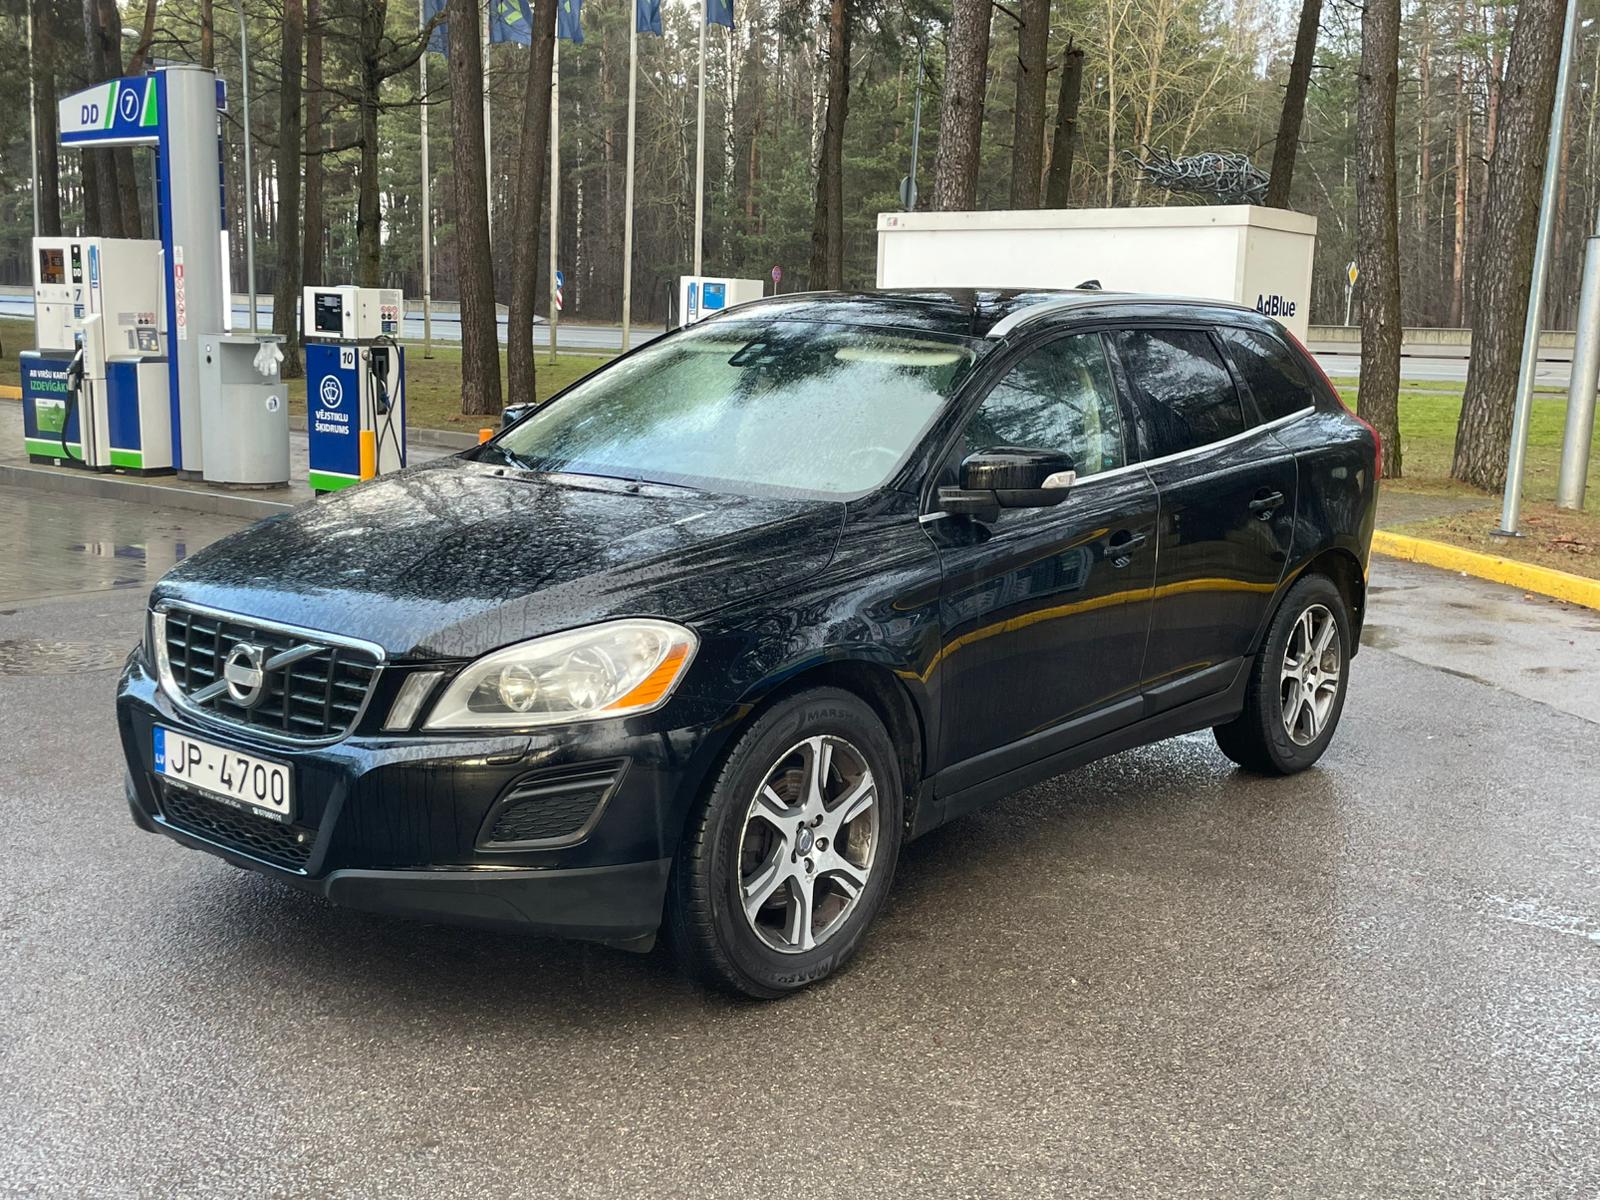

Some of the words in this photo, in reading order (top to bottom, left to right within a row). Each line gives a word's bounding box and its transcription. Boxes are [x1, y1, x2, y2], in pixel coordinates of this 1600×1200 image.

[125, 95, 134, 115] 7
[81, 104, 99, 125] DD
[73, 268, 82, 277] DD
[75, 289, 82, 302] 7
[1256, 294, 1296, 317] AdBlue
[342, 352, 354, 365] 10
[155, 753, 165, 764] LV
[171, 740, 284, 806] JP-4700
